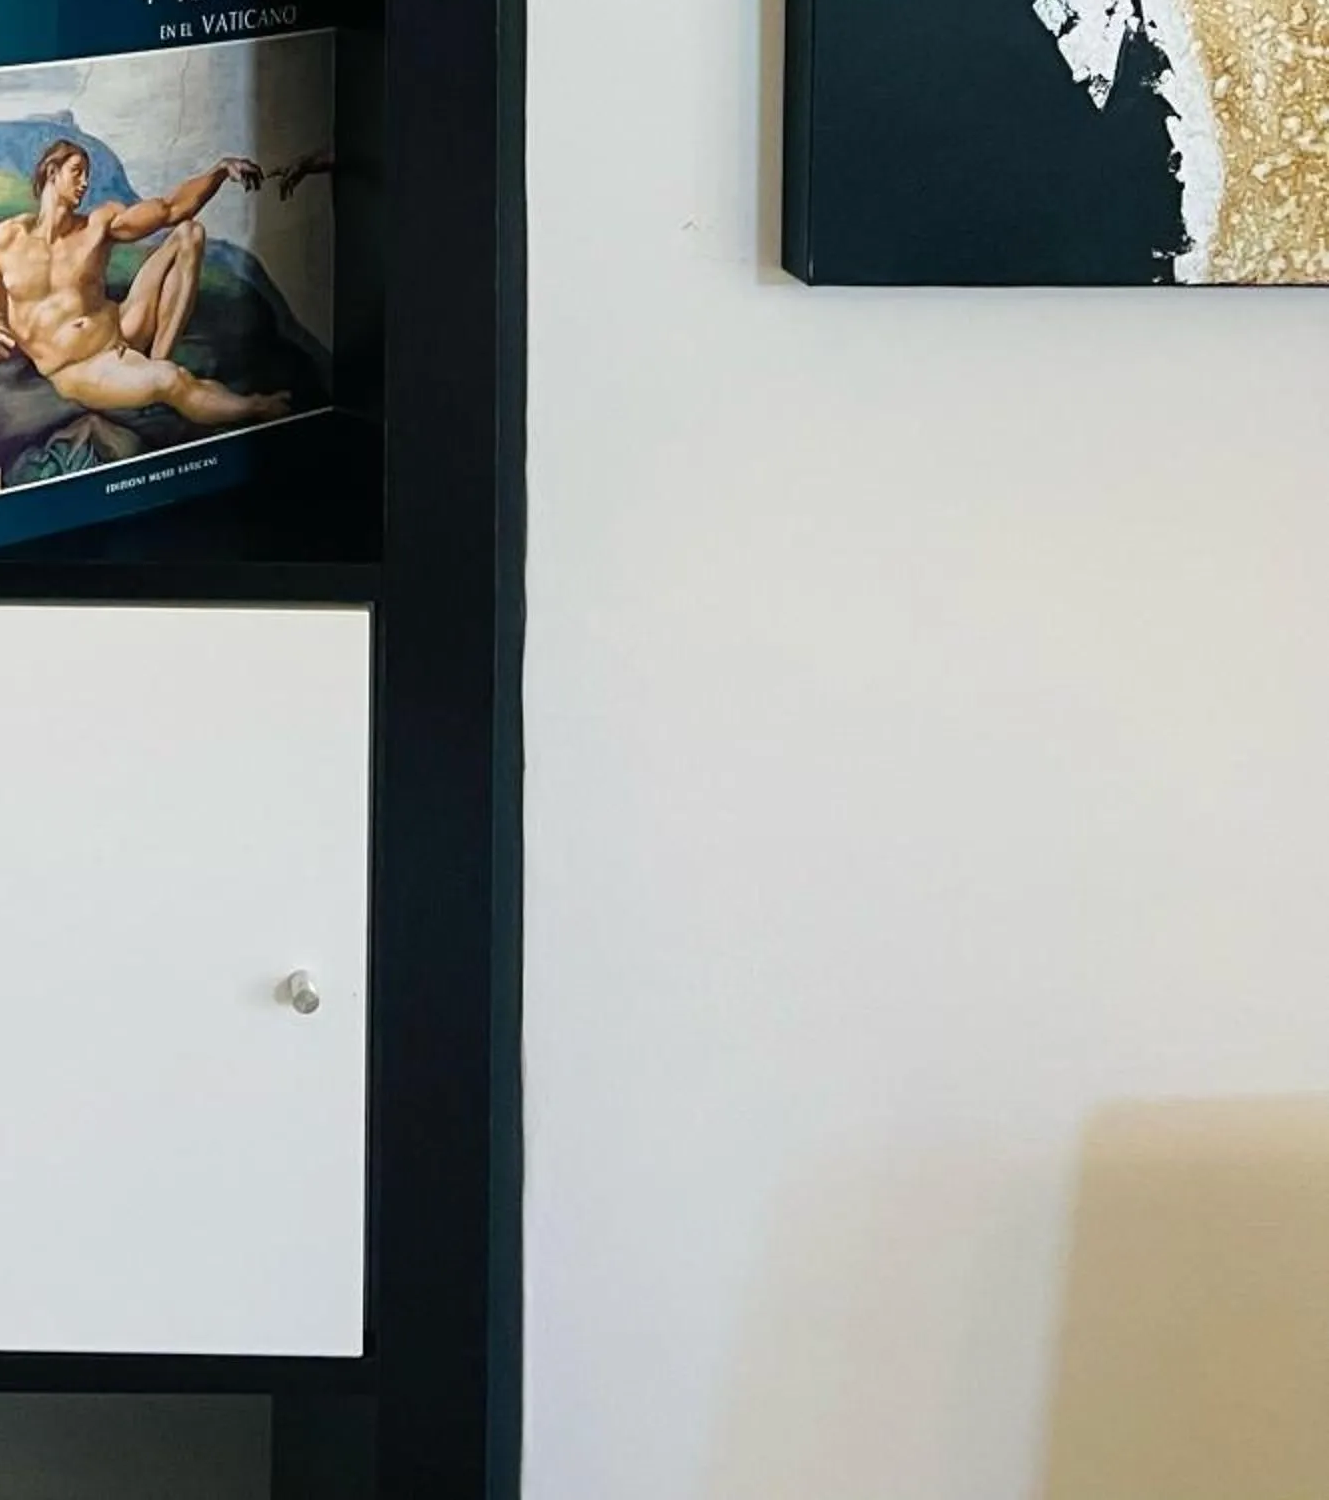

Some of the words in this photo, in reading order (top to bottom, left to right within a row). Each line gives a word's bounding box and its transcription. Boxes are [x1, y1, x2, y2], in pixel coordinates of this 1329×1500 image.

[159, 23, 177, 41] EN
[180, 21, 194, 37] EL
[201, 4, 298, 35] VATICANO
